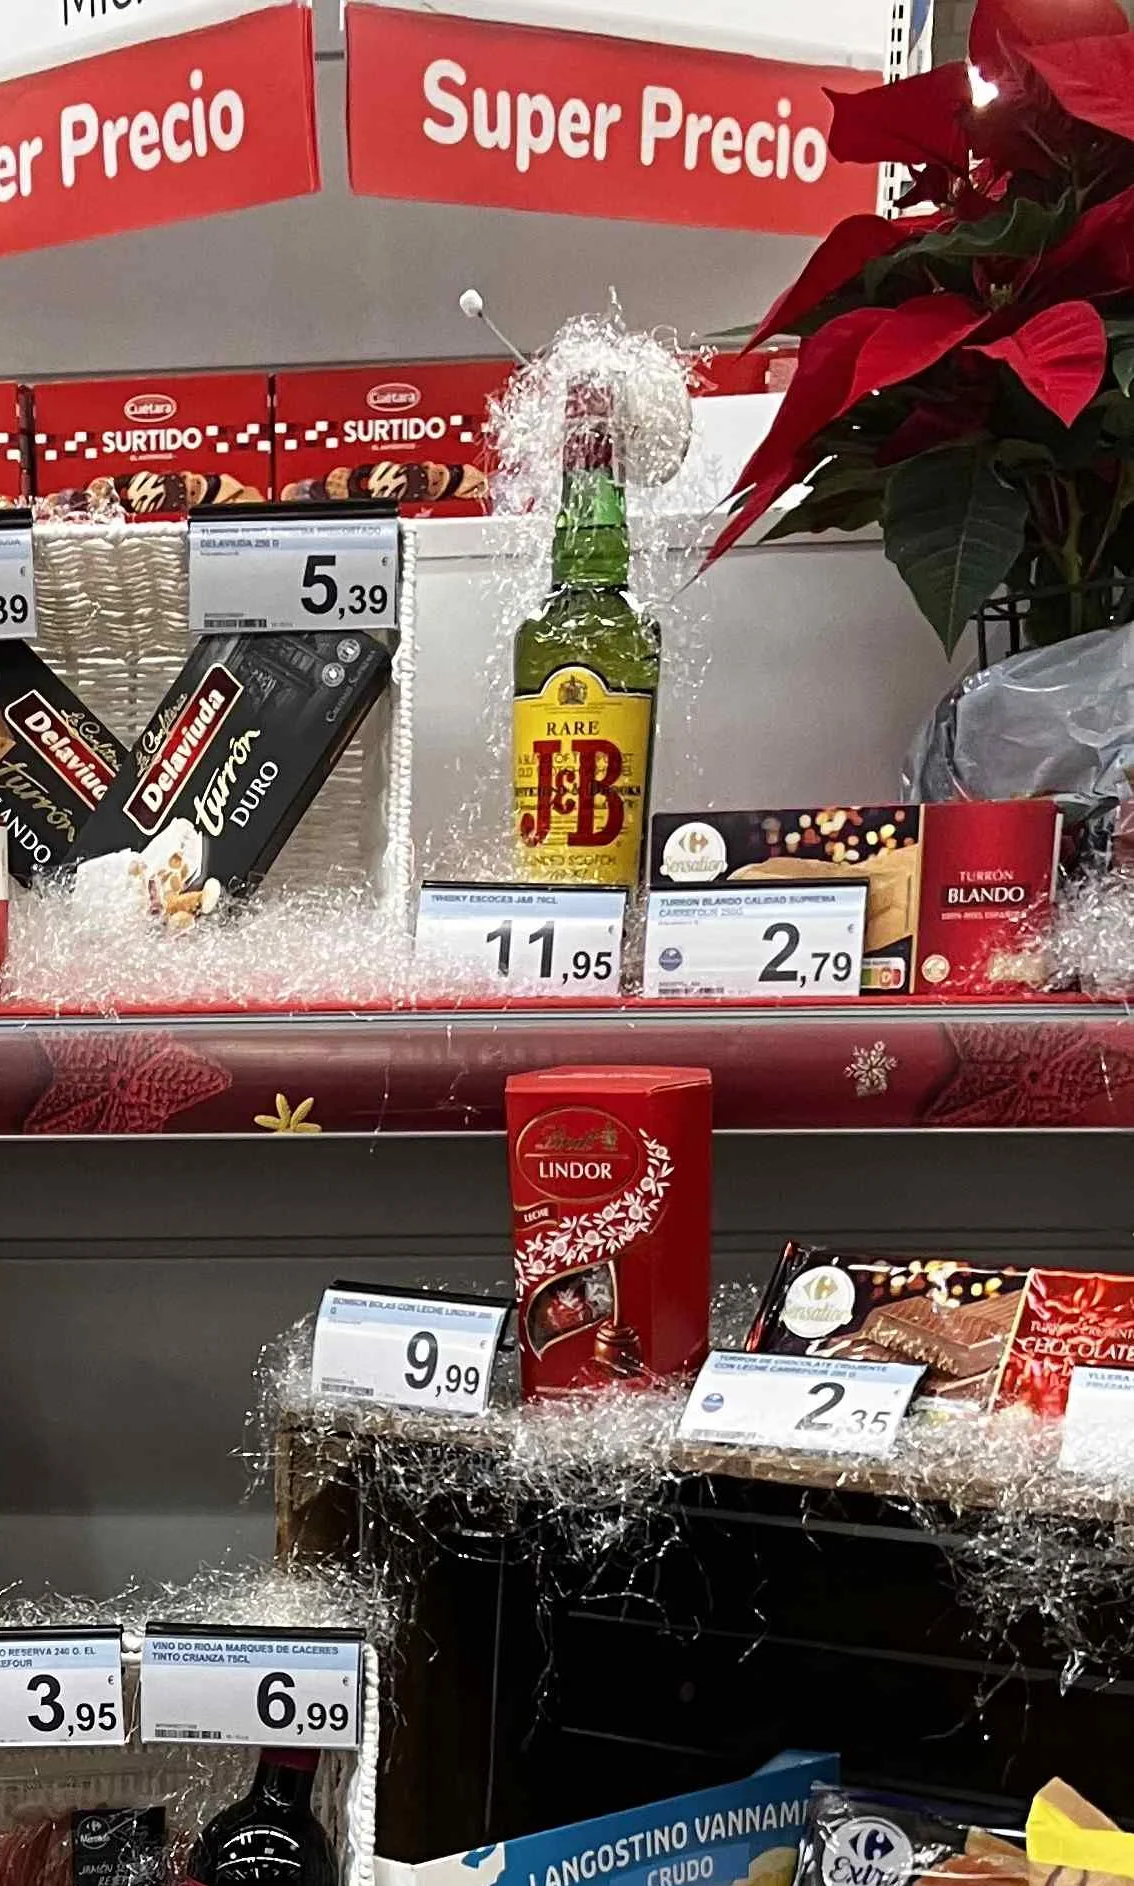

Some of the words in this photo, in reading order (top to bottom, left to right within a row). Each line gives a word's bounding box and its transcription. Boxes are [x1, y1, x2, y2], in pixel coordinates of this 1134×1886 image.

[59, 68, 246, 188] Precio
[422, 58, 622, 174] Super
[640, 85, 828, 184] Precio
[102, 427, 203, 454] SURTIDO
[343, 416, 446, 443] SURTIDO
[300, 554, 388, 620] 5,39
[141, 686, 227, 814] Delaviuda
[546, 720, 600, 736] RARE
[194, 727, 262, 839] turrón
[229, 759, 280, 829] DURO
[947, 886, 1025, 904] BLANDO
[959, 868, 1014, 882] TURRÓN
[486, 919, 613, 985] 11,95
[758, 922, 852, 988] 2,79
[539, 1160, 613, 1180] LINDOR
[523, 1207, 550, 1223] LECHE
[404, 1330, 480, 1398] 9,99
[794, 1381, 893, 1436] 2,35
[8, 1646, 53, 1657] RESERVA
[84, 1646, 97, 1655] EL
[152, 1641, 176, 1651] VINO
[177, 1642, 193, 1651] DO
[194, 1643, 224, 1652] RIOJA
[225, 1643, 274, 1653] MARQUES
[276, 1644, 289, 1654] DE
[291, 1645, 339, 1655] CACERES
[152, 1652, 181, 1662] TINTO
[182, 1653, 225, 1663] CRIANZA
[27, 1673, 117, 1738] 3,95
[256, 1671, 349, 1735] 6,99
